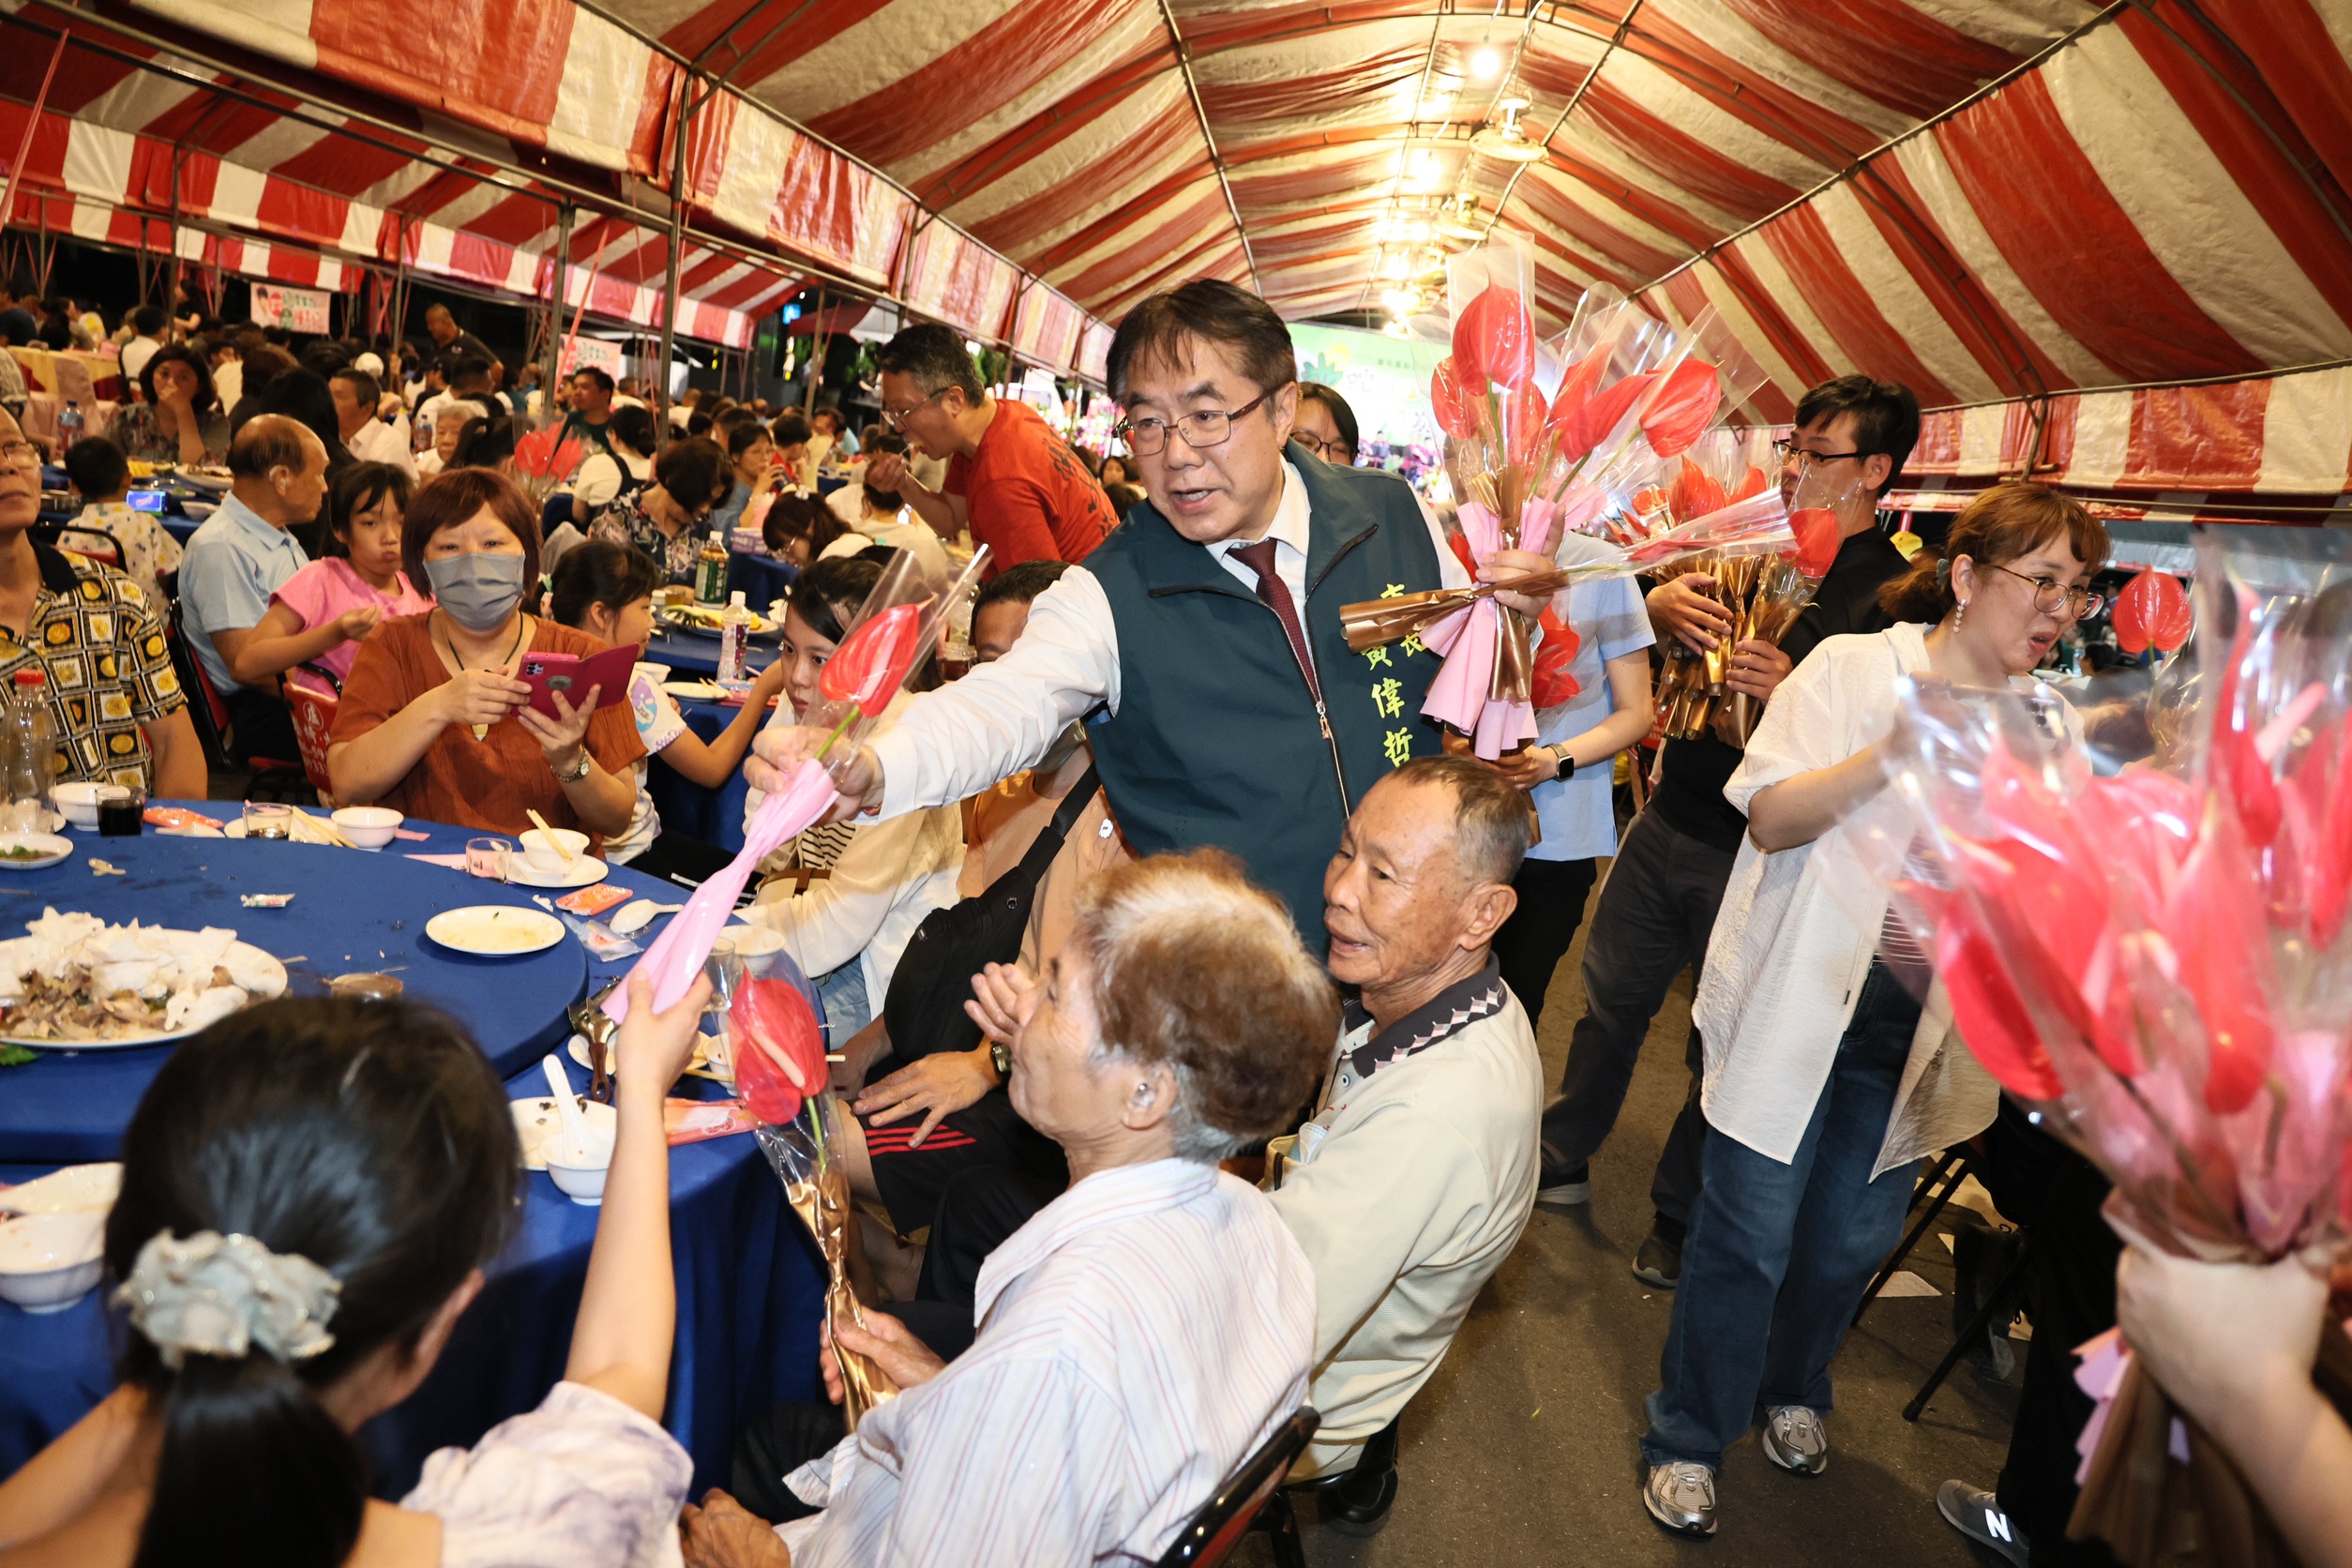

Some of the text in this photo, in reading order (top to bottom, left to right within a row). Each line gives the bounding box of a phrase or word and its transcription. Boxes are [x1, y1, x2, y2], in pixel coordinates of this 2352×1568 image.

[1361, 644, 1413, 768] 黃偉哲
[1984, 1508, 2013, 1543] N
